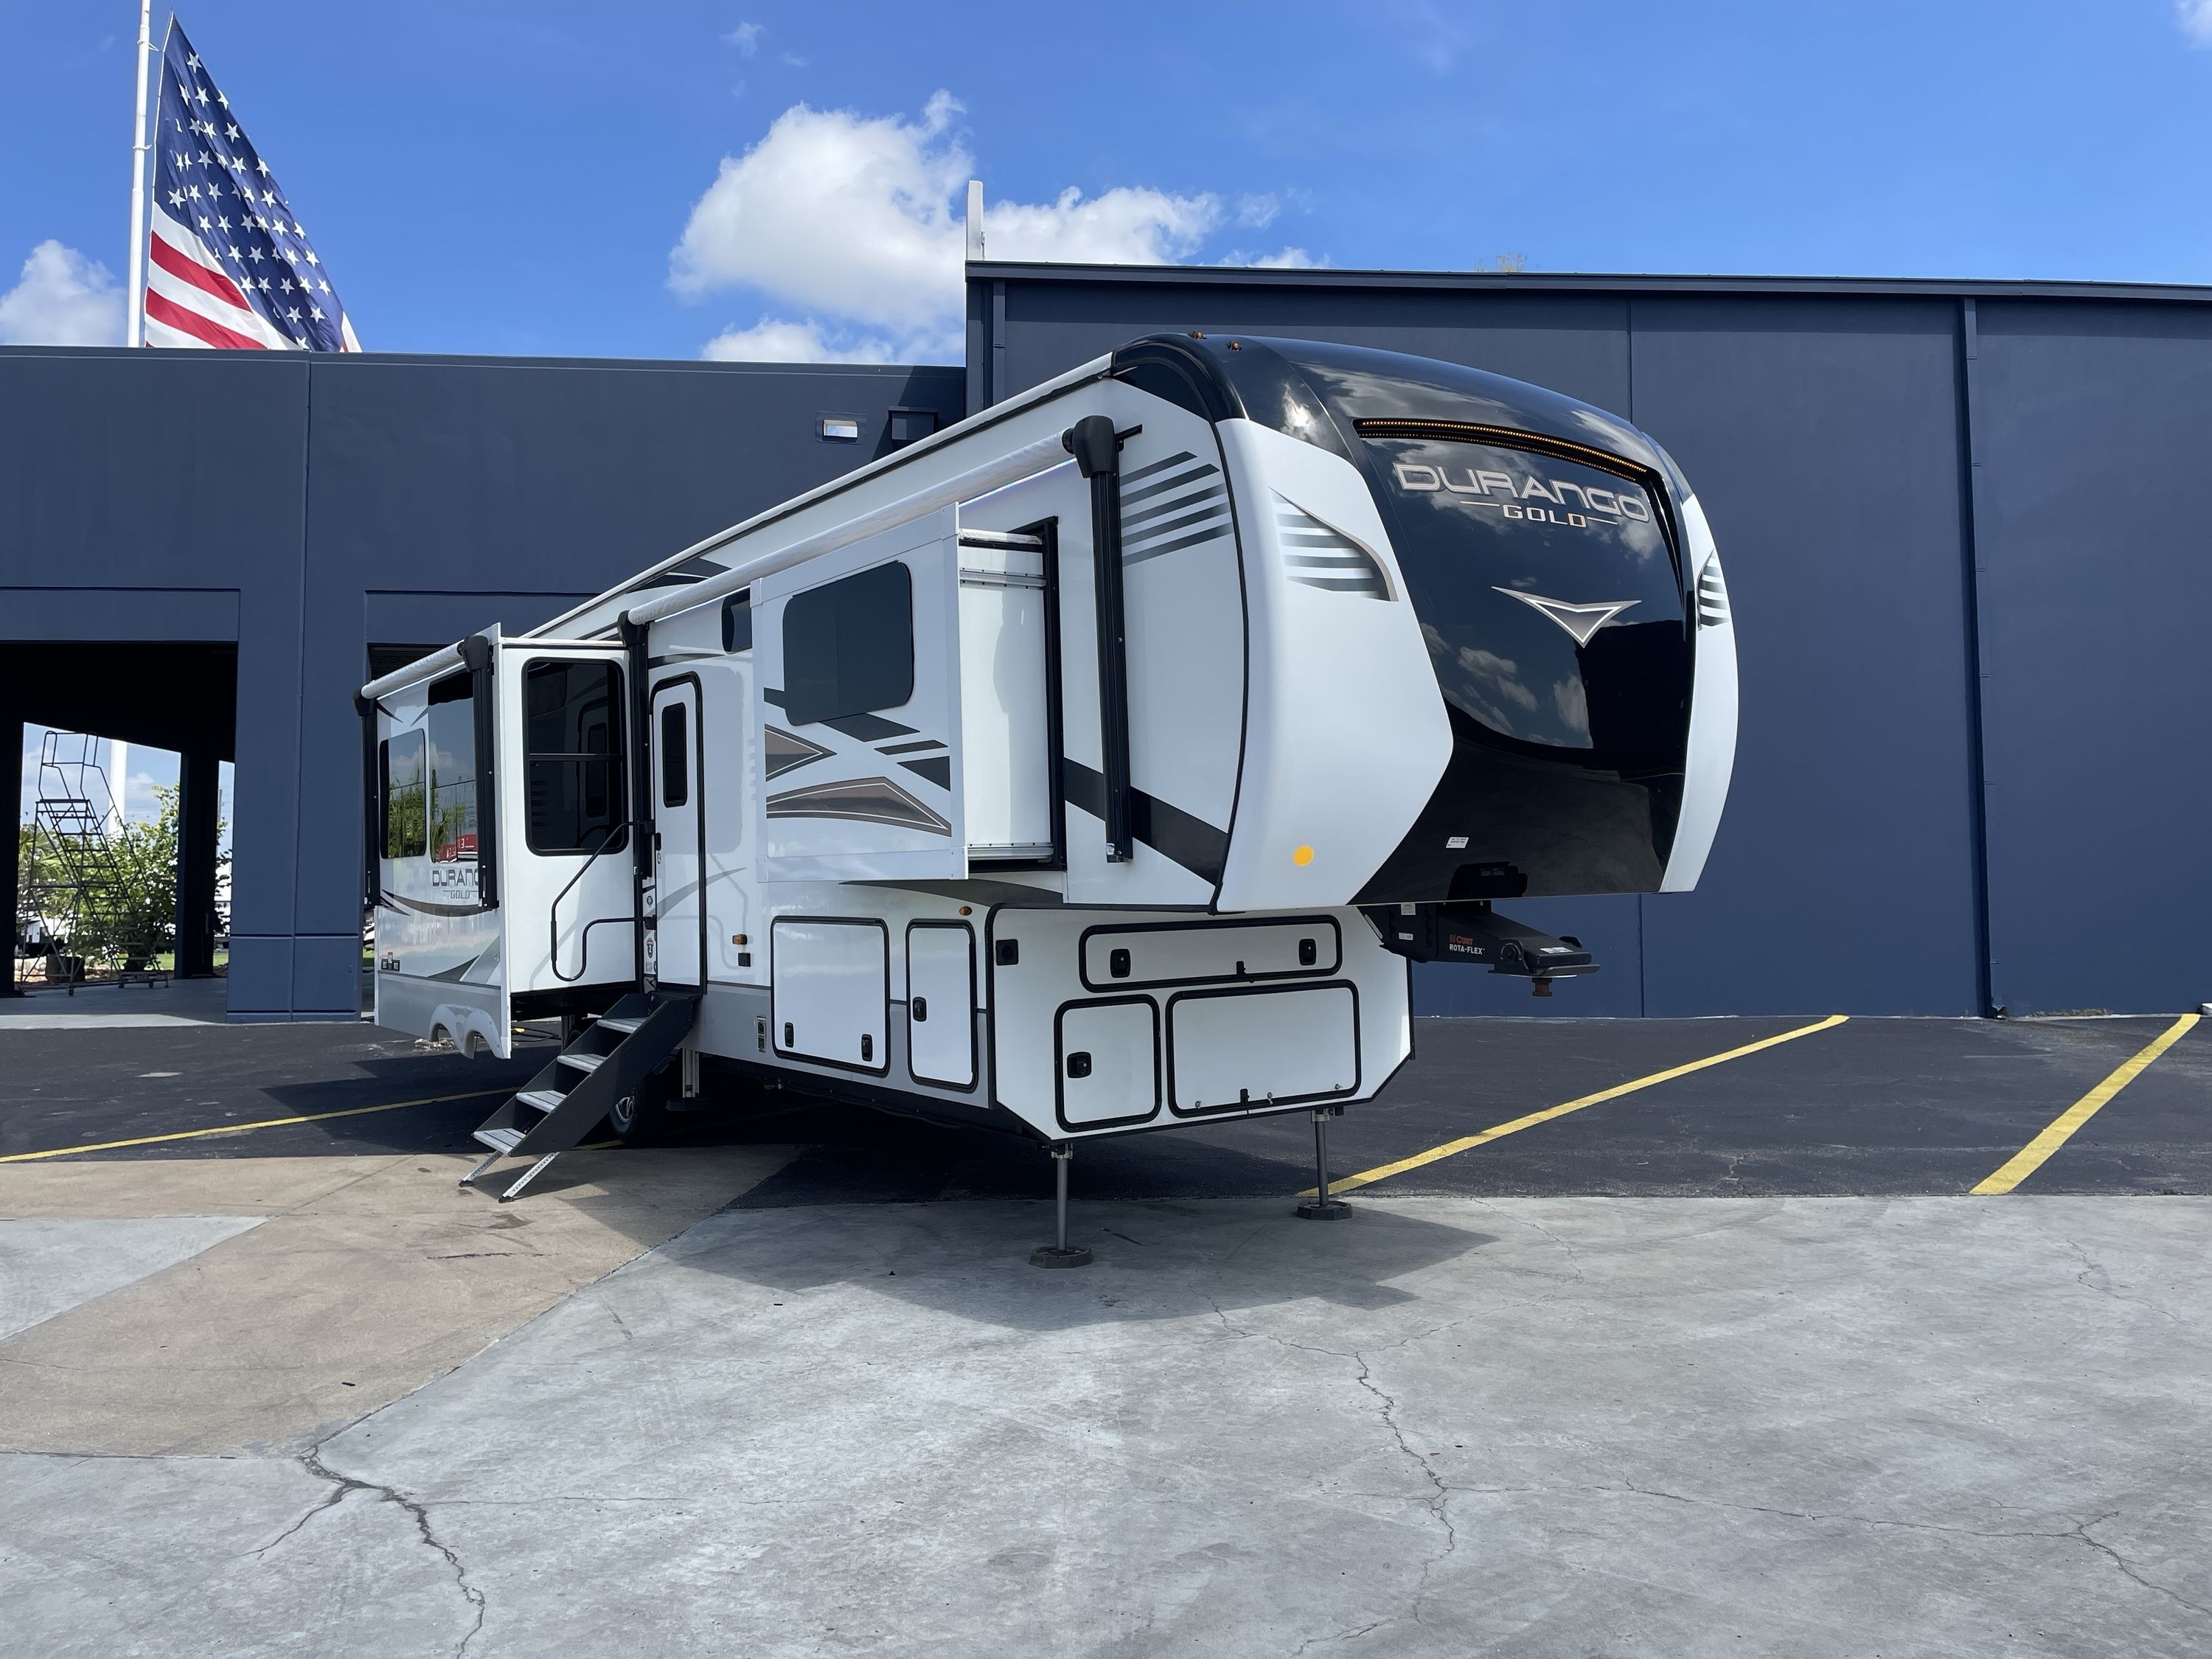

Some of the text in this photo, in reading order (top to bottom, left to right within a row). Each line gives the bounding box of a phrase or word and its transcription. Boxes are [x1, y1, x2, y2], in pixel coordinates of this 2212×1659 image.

[1393, 462, 1649, 523] DURANGO
[1503, 504, 1587, 528] GOLD
[433, 869, 478, 886] DURAN
[451, 890, 470, 899] GOLD
